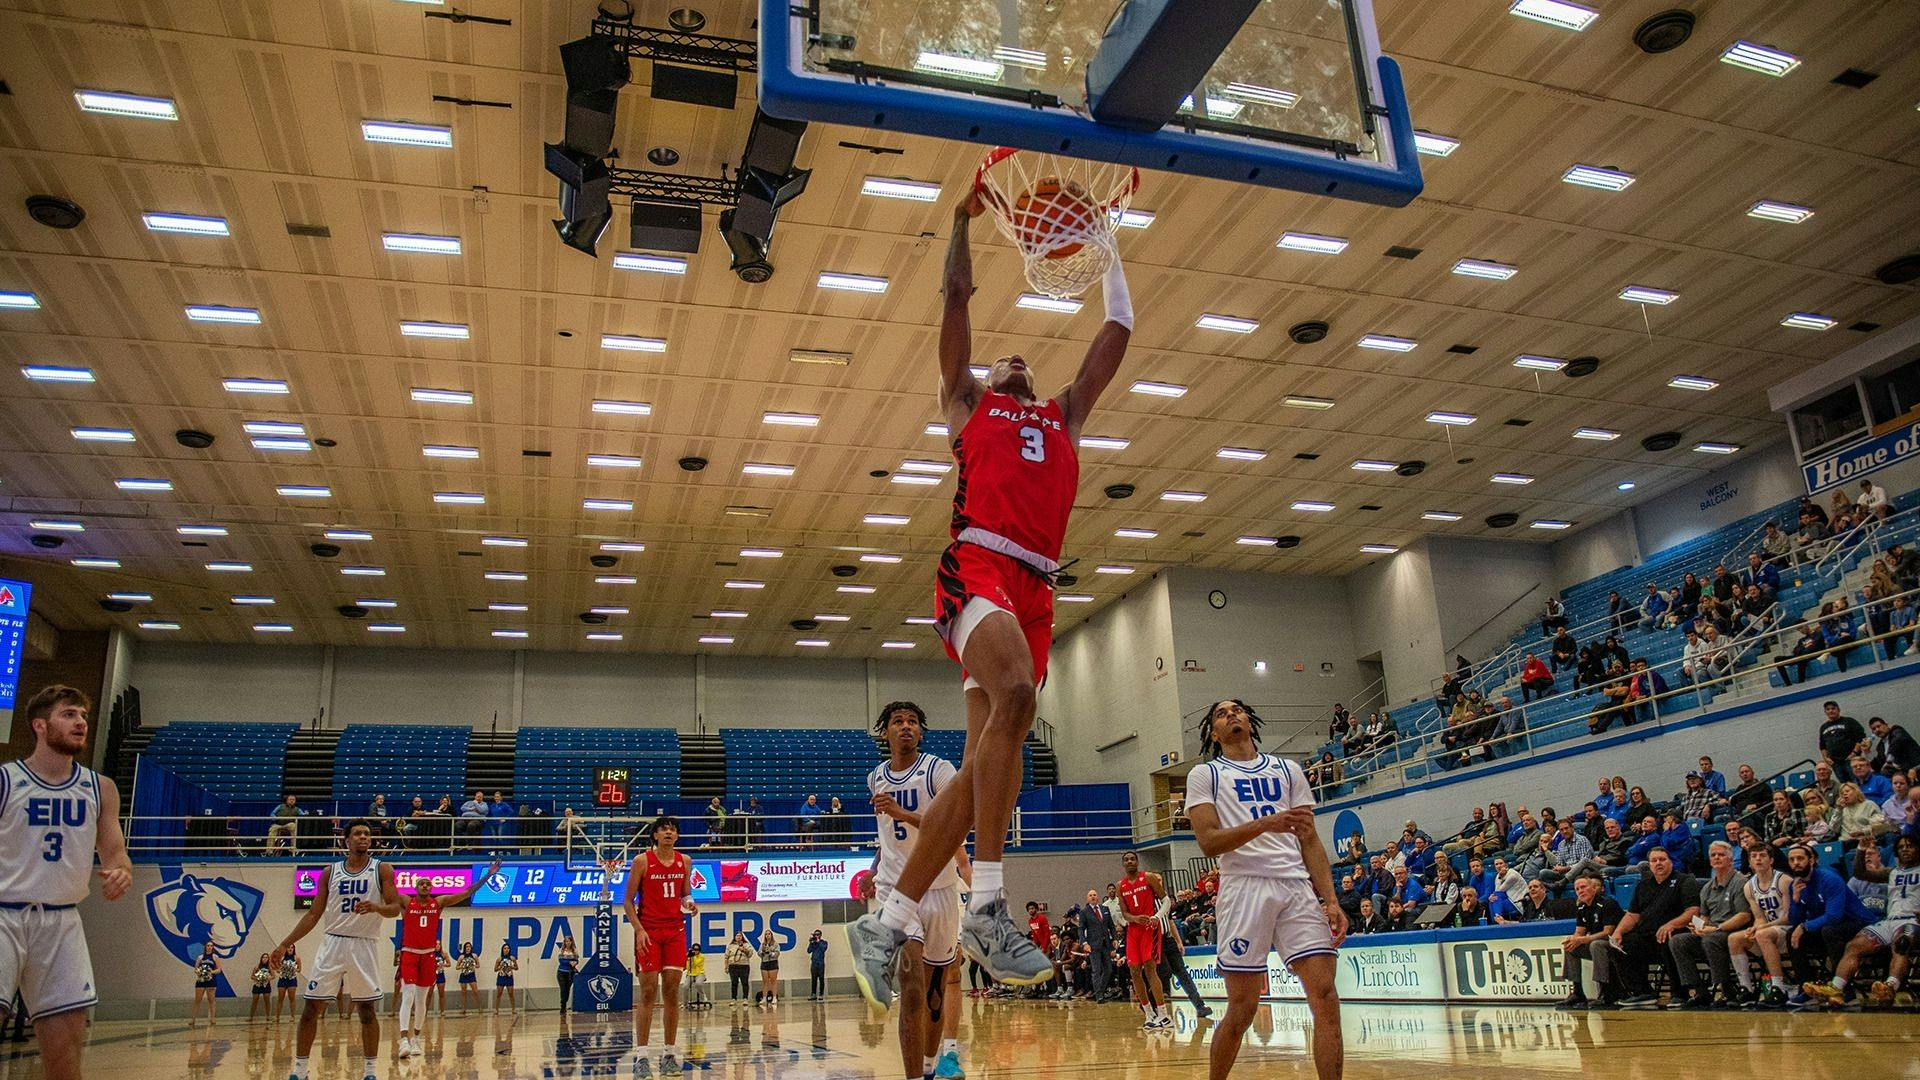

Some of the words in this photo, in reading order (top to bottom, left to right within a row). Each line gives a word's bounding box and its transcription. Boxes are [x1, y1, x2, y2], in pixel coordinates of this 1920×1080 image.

[1019, 425, 1045, 463] 3
[1814, 446, 1888, 489] Home
[1895, 423, 1920, 456] of
[1706, 481, 1729, 498] WEST
[1700, 487, 1739, 511] BALCONY
[601, 770, 627, 780] 11:24
[1233, 777, 1282, 802] EIU
[24, 798, 86, 827] EIU
[893, 819, 907, 840] 5
[43, 832, 63, 862] 3
[760, 861, 845, 875] slumberland
[396, 872, 465, 888] fitess
[525, 869, 544, 885] 12
[1894, 874, 1919, 887] EIU
[337, 879, 368, 895] EIU
[663, 881, 675, 898] 11
[1901, 886, 1906, 899] 1
[511, 894, 522, 903] TO
[527, 892, 535, 902] 4
[558, 894, 565, 903] 6
[1132, 894, 1139, 907] 1
[1758, 896, 1779, 911] EIU
[419, 915, 428, 928] 0
[598, 904, 610, 968] PANTHERS
[1360, 950, 1387, 965] Sarah
[1391, 948, 1417, 964] Bush
[1491, 948, 1567, 984] HOTE
[1361, 964, 1420, 986] Lincoln
[1492, 984, 1532, 996] UNIQUE
